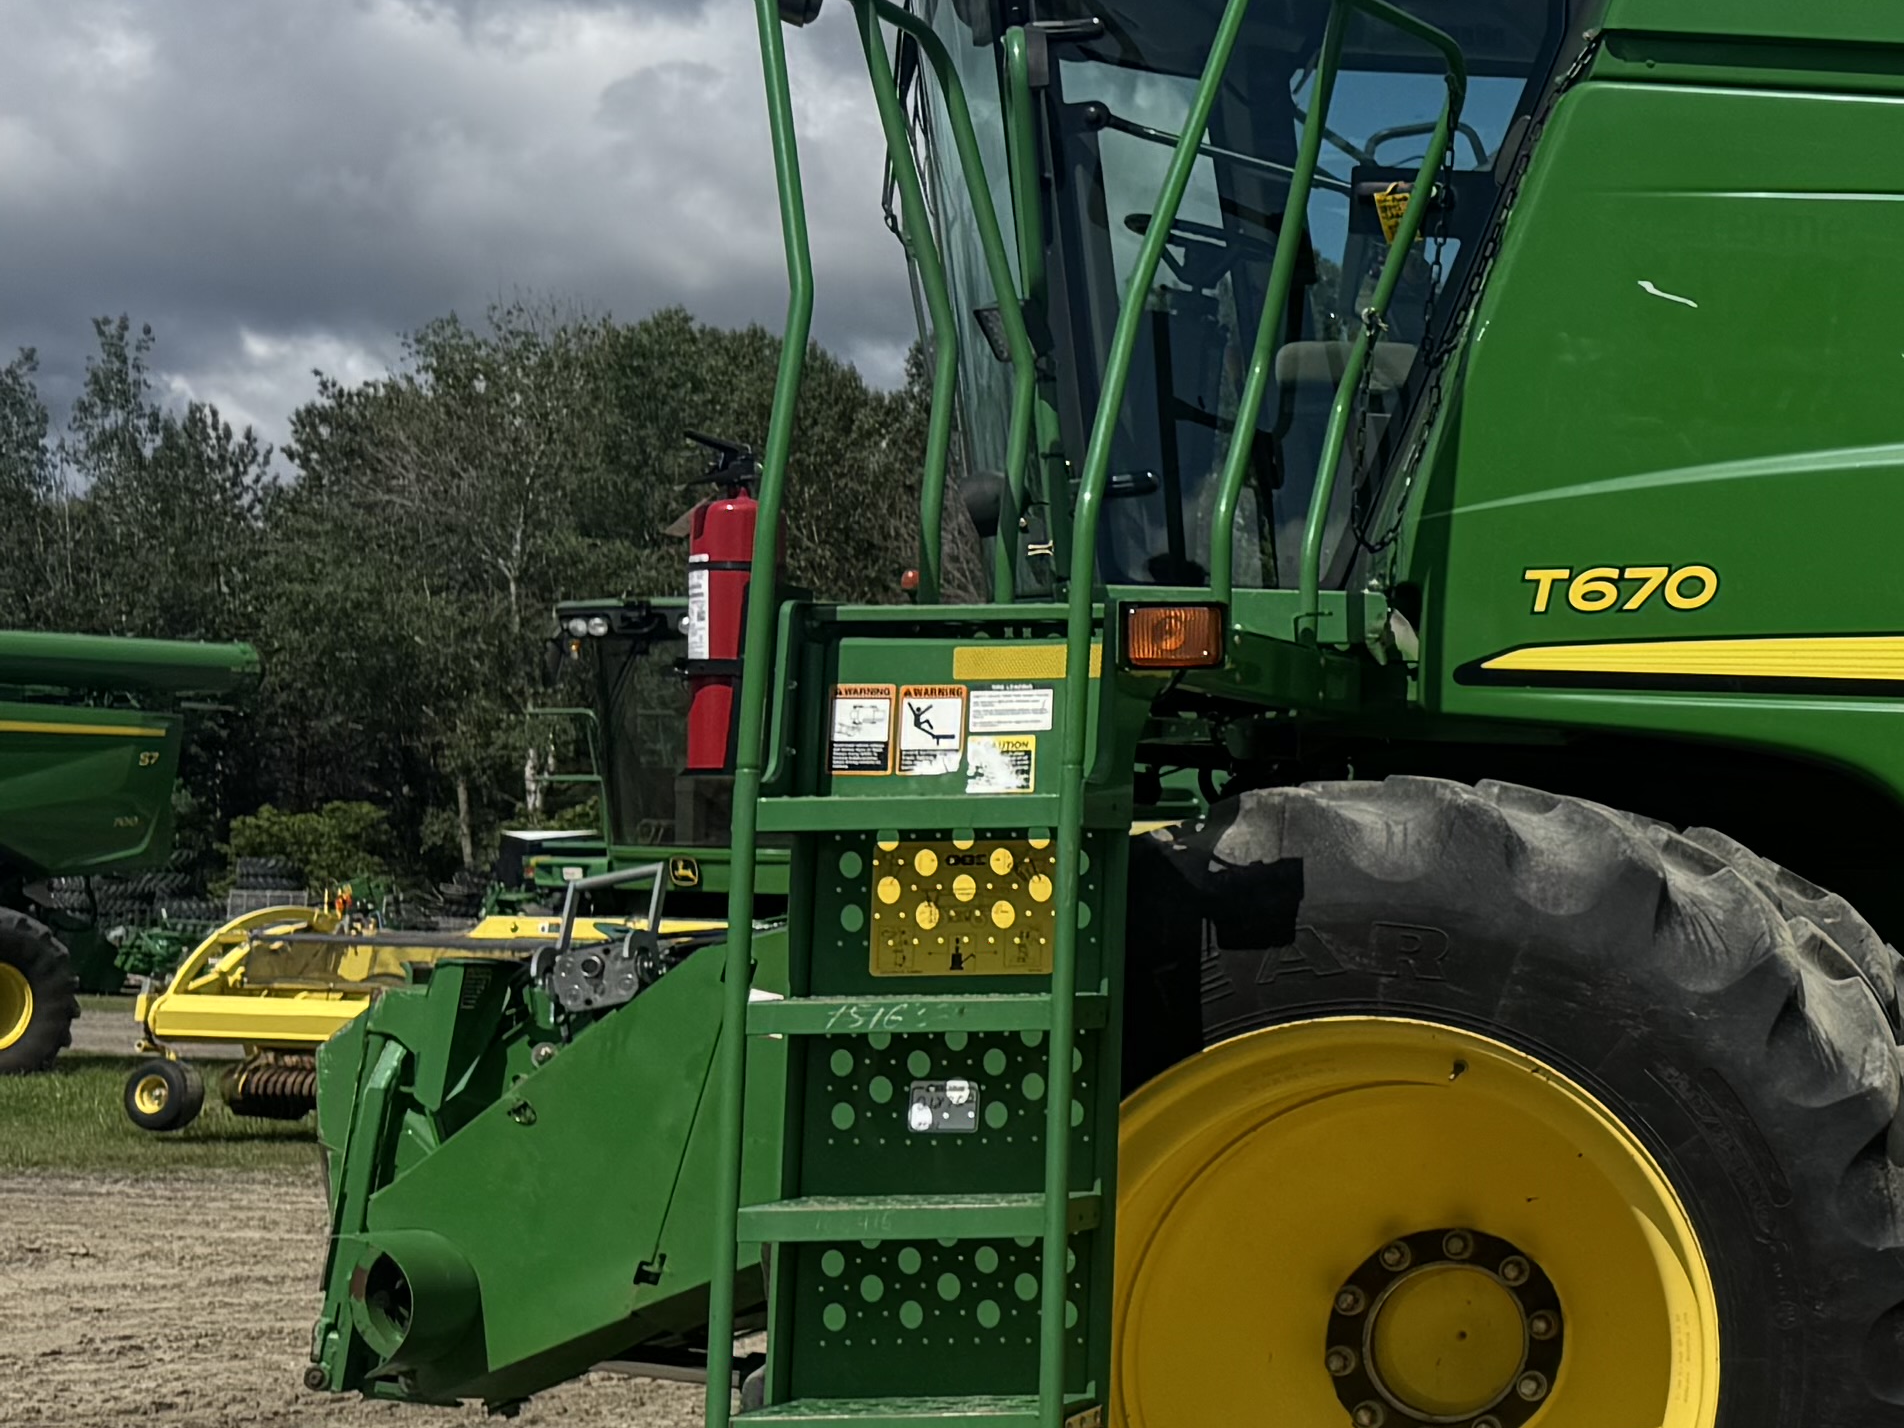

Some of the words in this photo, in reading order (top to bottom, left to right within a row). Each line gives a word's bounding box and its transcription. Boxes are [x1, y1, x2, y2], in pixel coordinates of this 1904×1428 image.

[1524, 567, 1718, 614] T670
[844, 688, 891, 696] WARNING
[911, 687, 963, 697] WARNING
